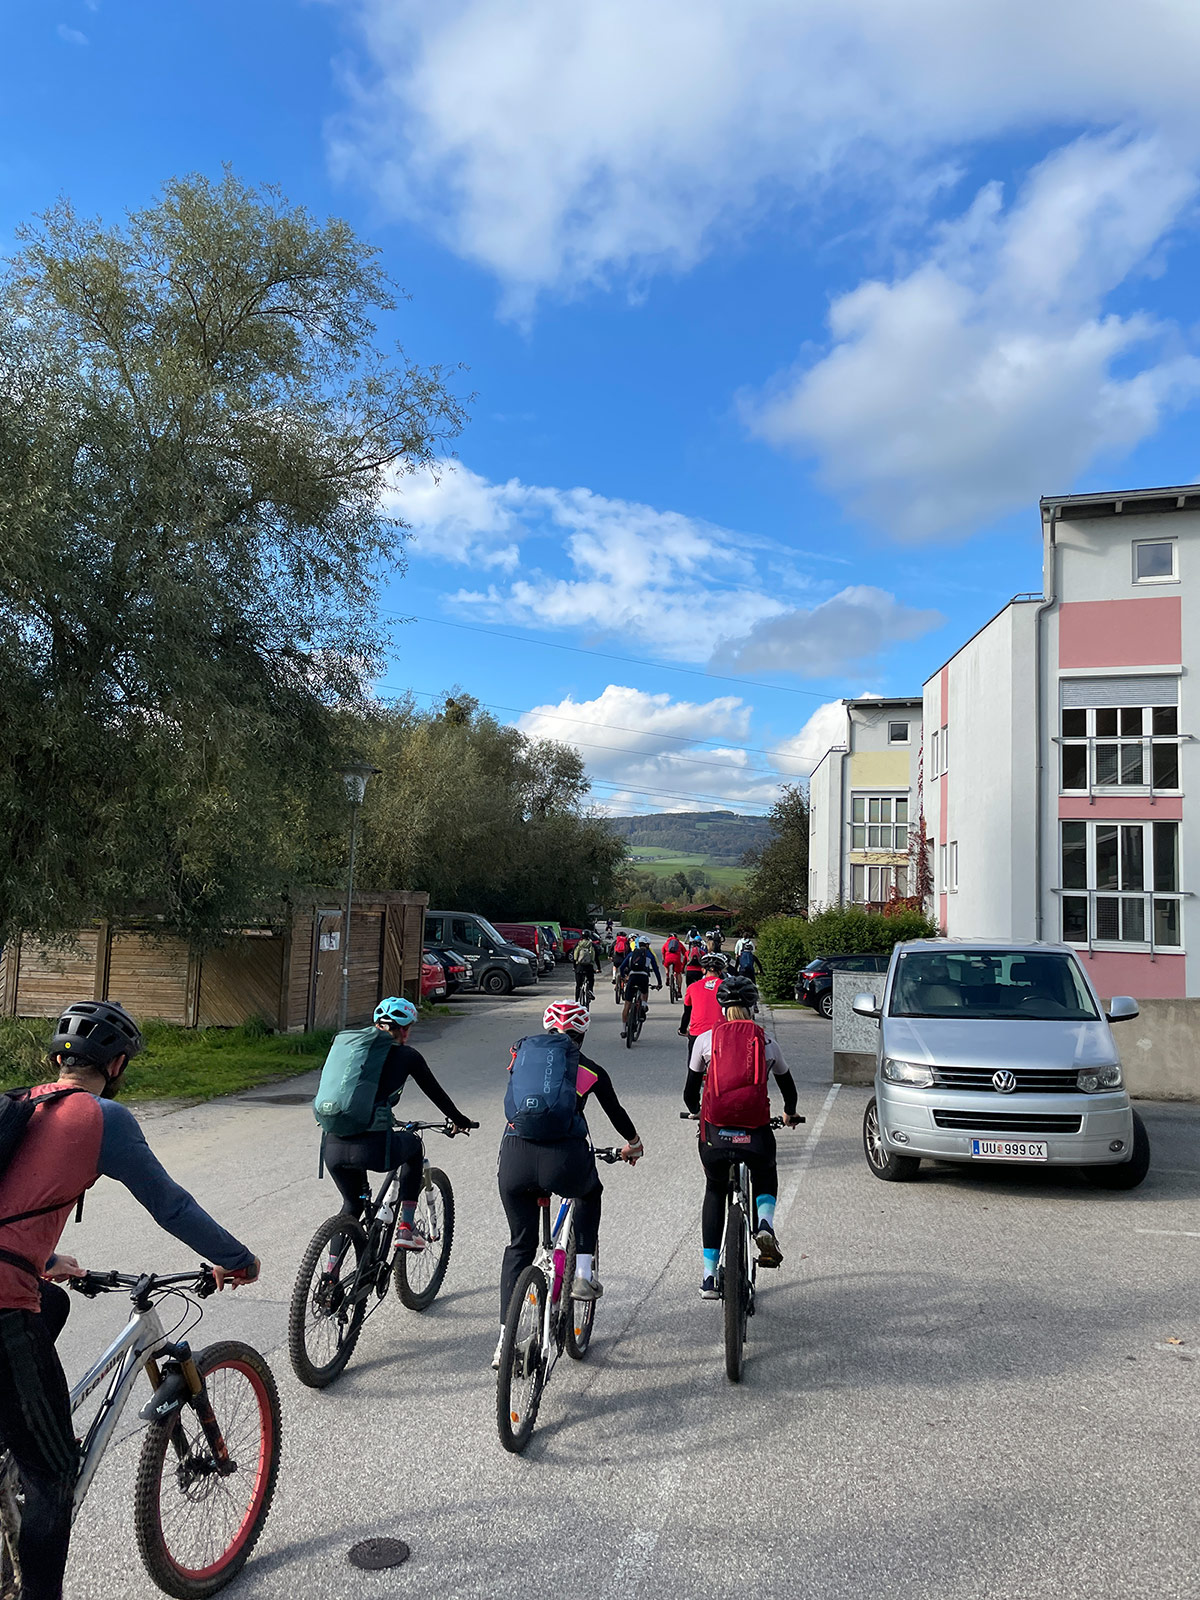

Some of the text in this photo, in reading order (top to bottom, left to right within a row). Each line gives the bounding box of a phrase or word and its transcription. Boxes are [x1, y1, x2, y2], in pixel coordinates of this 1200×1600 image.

[543, 1049, 554, 1094] ORTOVOX
[981, 1142, 997, 1154] UU
[1004, 1143, 1026, 1156] 999
[1028, 1144, 1043, 1156] CX
